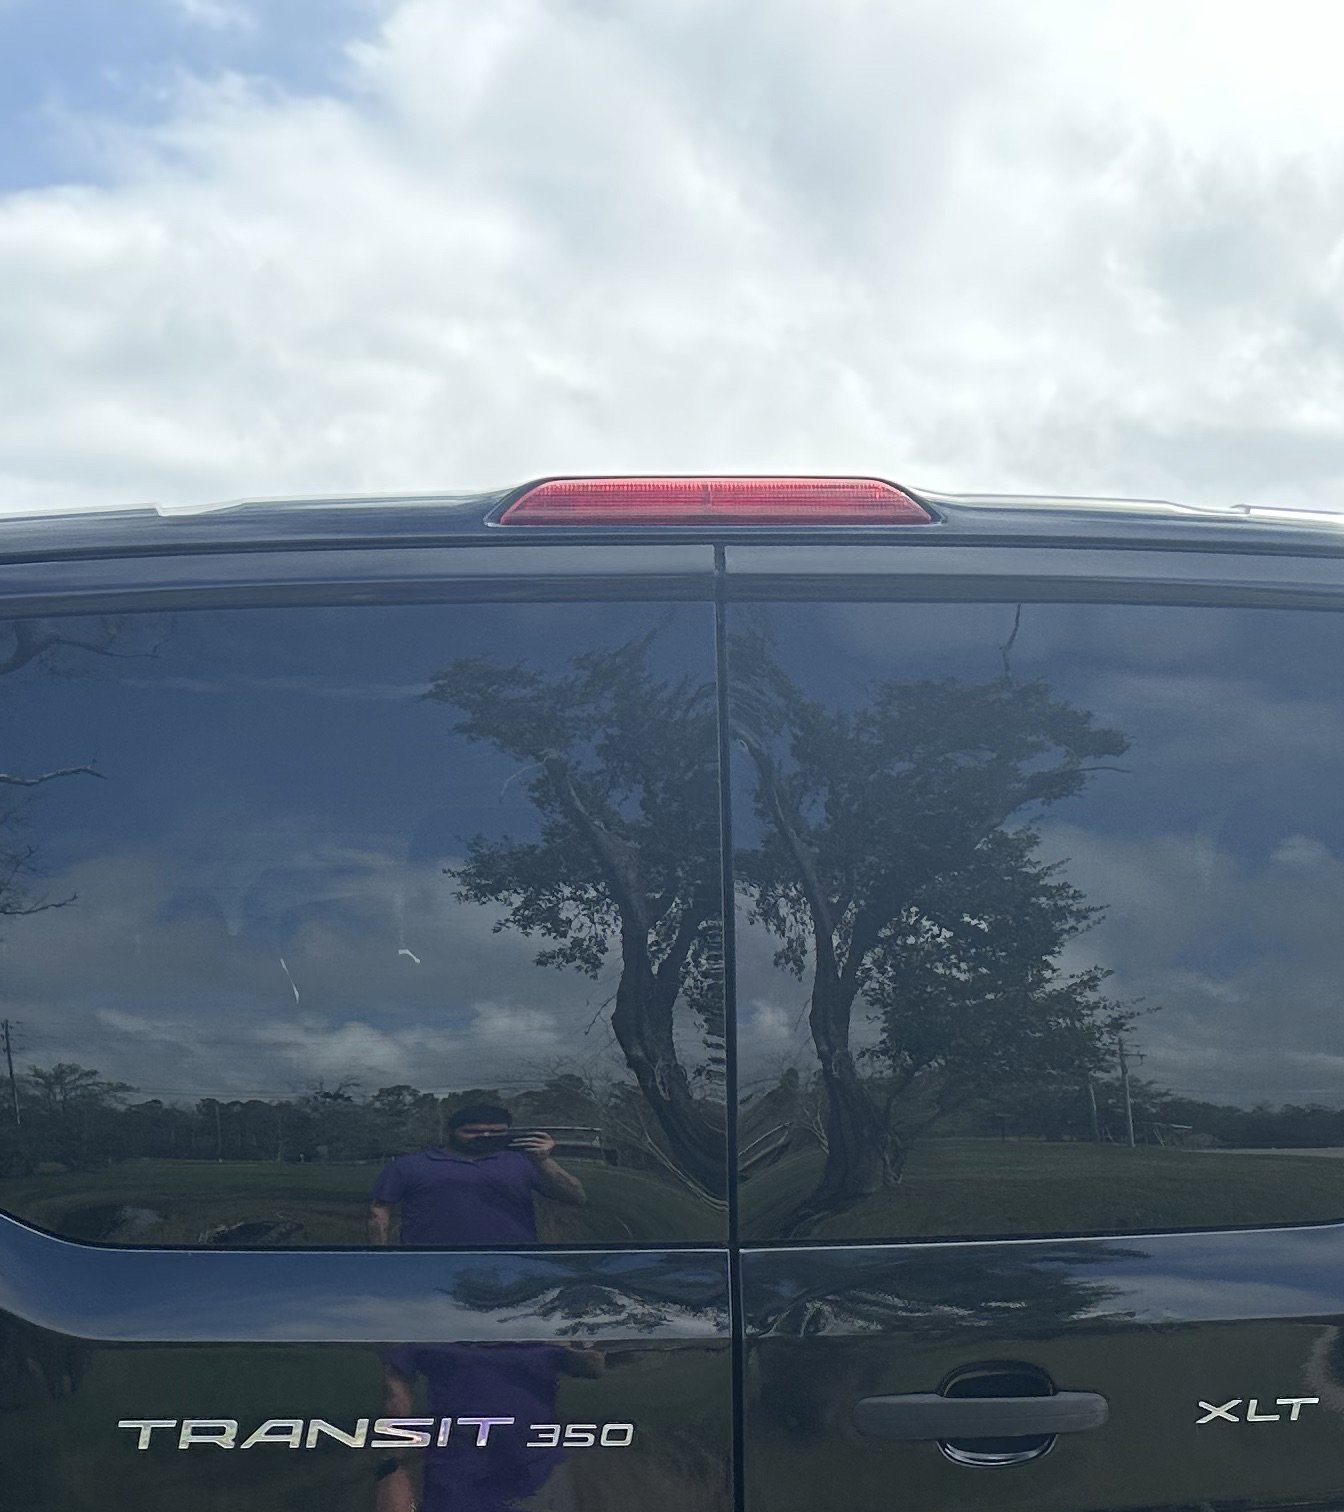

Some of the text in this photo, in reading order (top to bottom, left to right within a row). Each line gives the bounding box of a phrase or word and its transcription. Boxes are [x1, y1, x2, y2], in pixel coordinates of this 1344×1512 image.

[1195, 1397, 1320, 1424] XLT
[117, 1416, 635, 1449] TRANSIT 350
